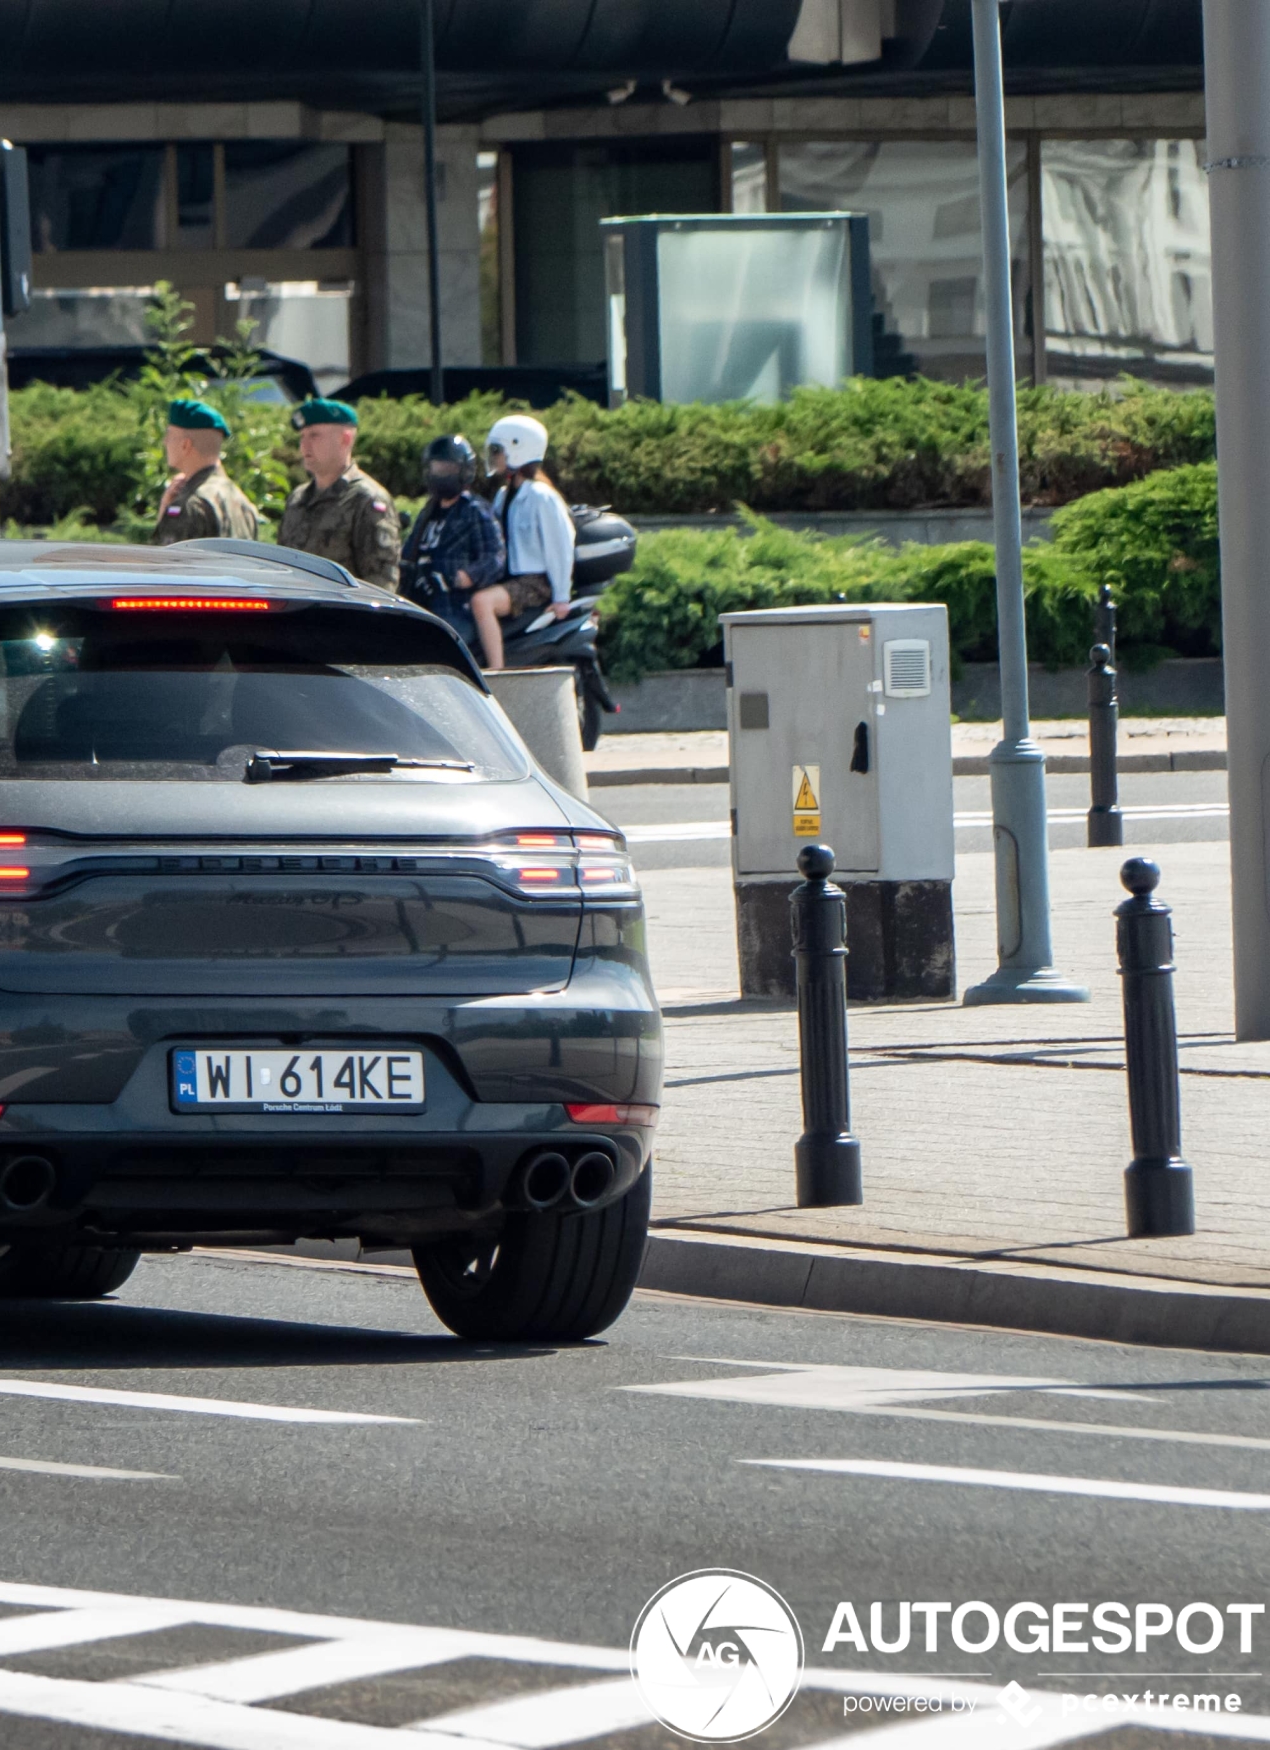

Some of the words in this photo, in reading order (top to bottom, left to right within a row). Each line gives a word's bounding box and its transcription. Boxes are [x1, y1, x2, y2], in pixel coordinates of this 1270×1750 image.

[161, 857, 417, 870] PORSCHE
[206, 1055, 253, 1099] WI
[279, 1055, 412, 1099] 614KE
[180, 1084, 195, 1096] PL
[263, 1103, 292, 1112] Porsche
[293, 1103, 325, 1112] Centrum
